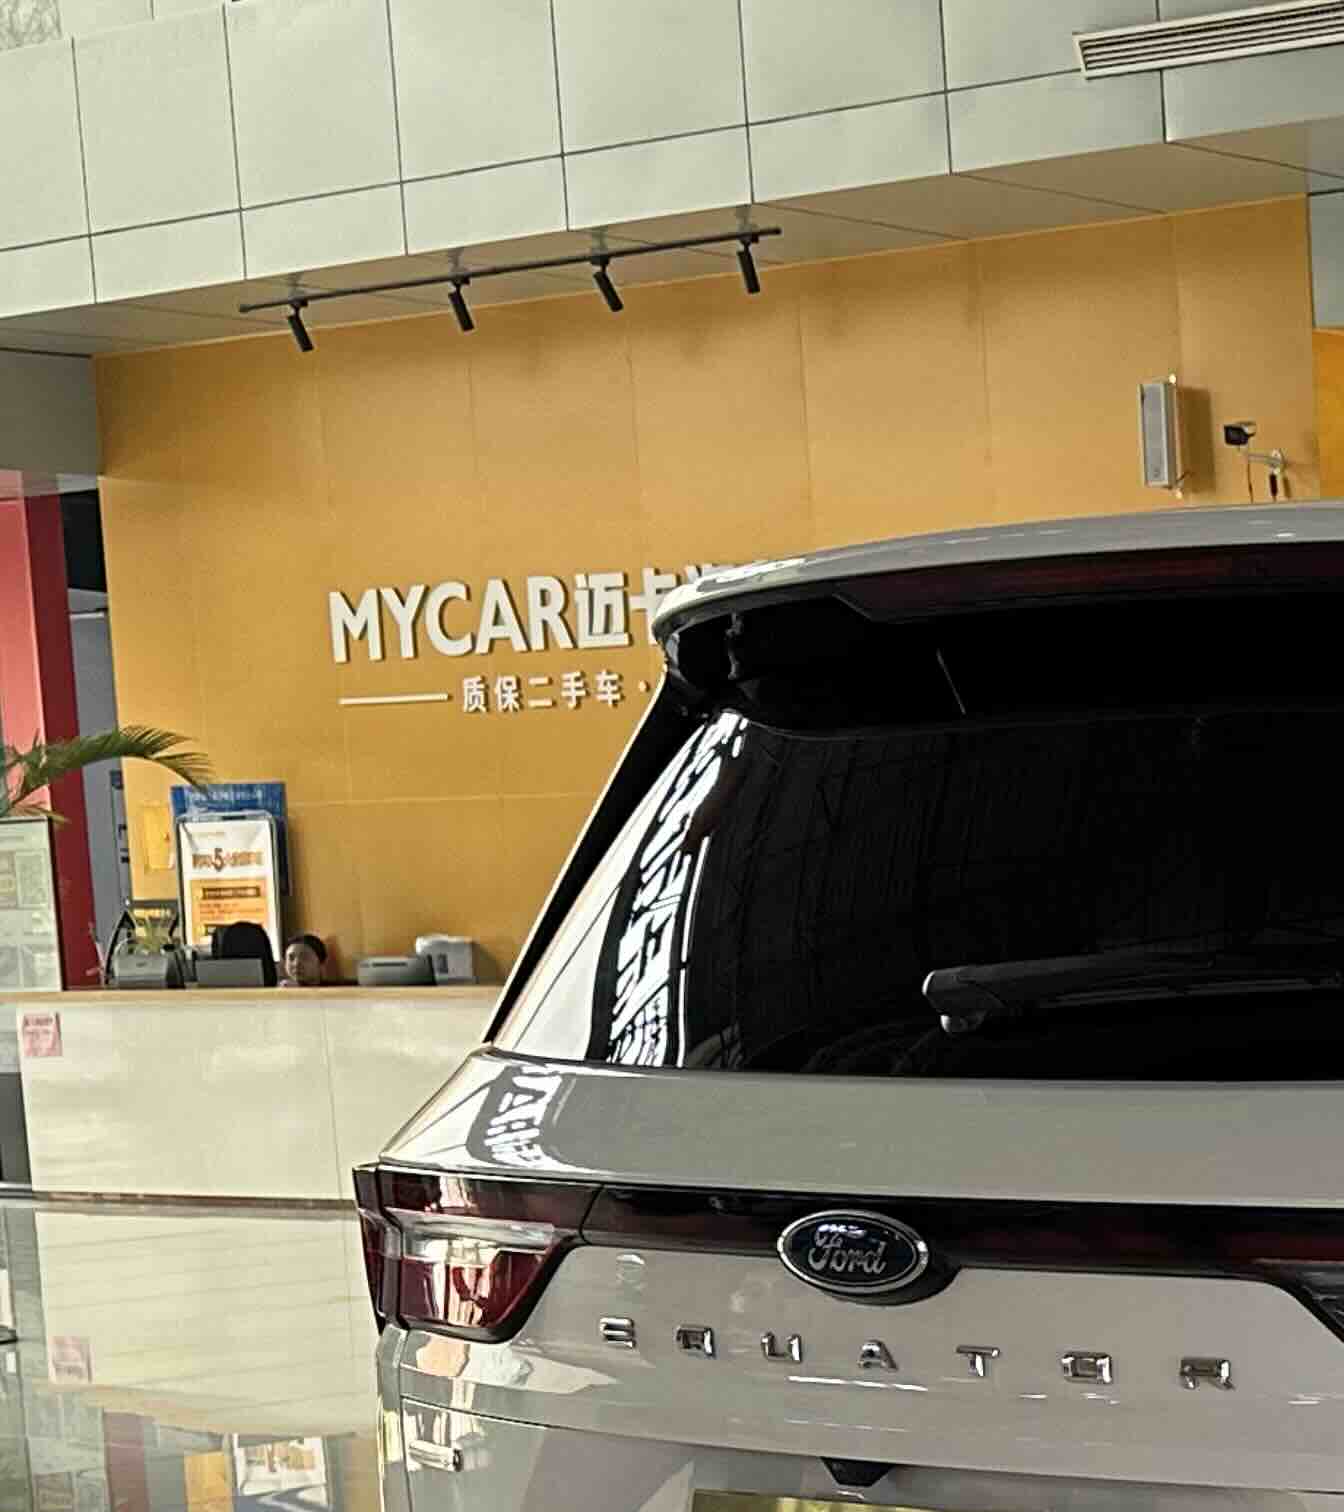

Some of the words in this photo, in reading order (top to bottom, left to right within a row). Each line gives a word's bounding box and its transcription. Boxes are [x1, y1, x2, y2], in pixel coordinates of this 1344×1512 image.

[327, 563, 722, 664] MYCAR迈卡
[807, 1222, 888, 1275] Ford
[599, 1315, 1236, 1390] EQUATOR
